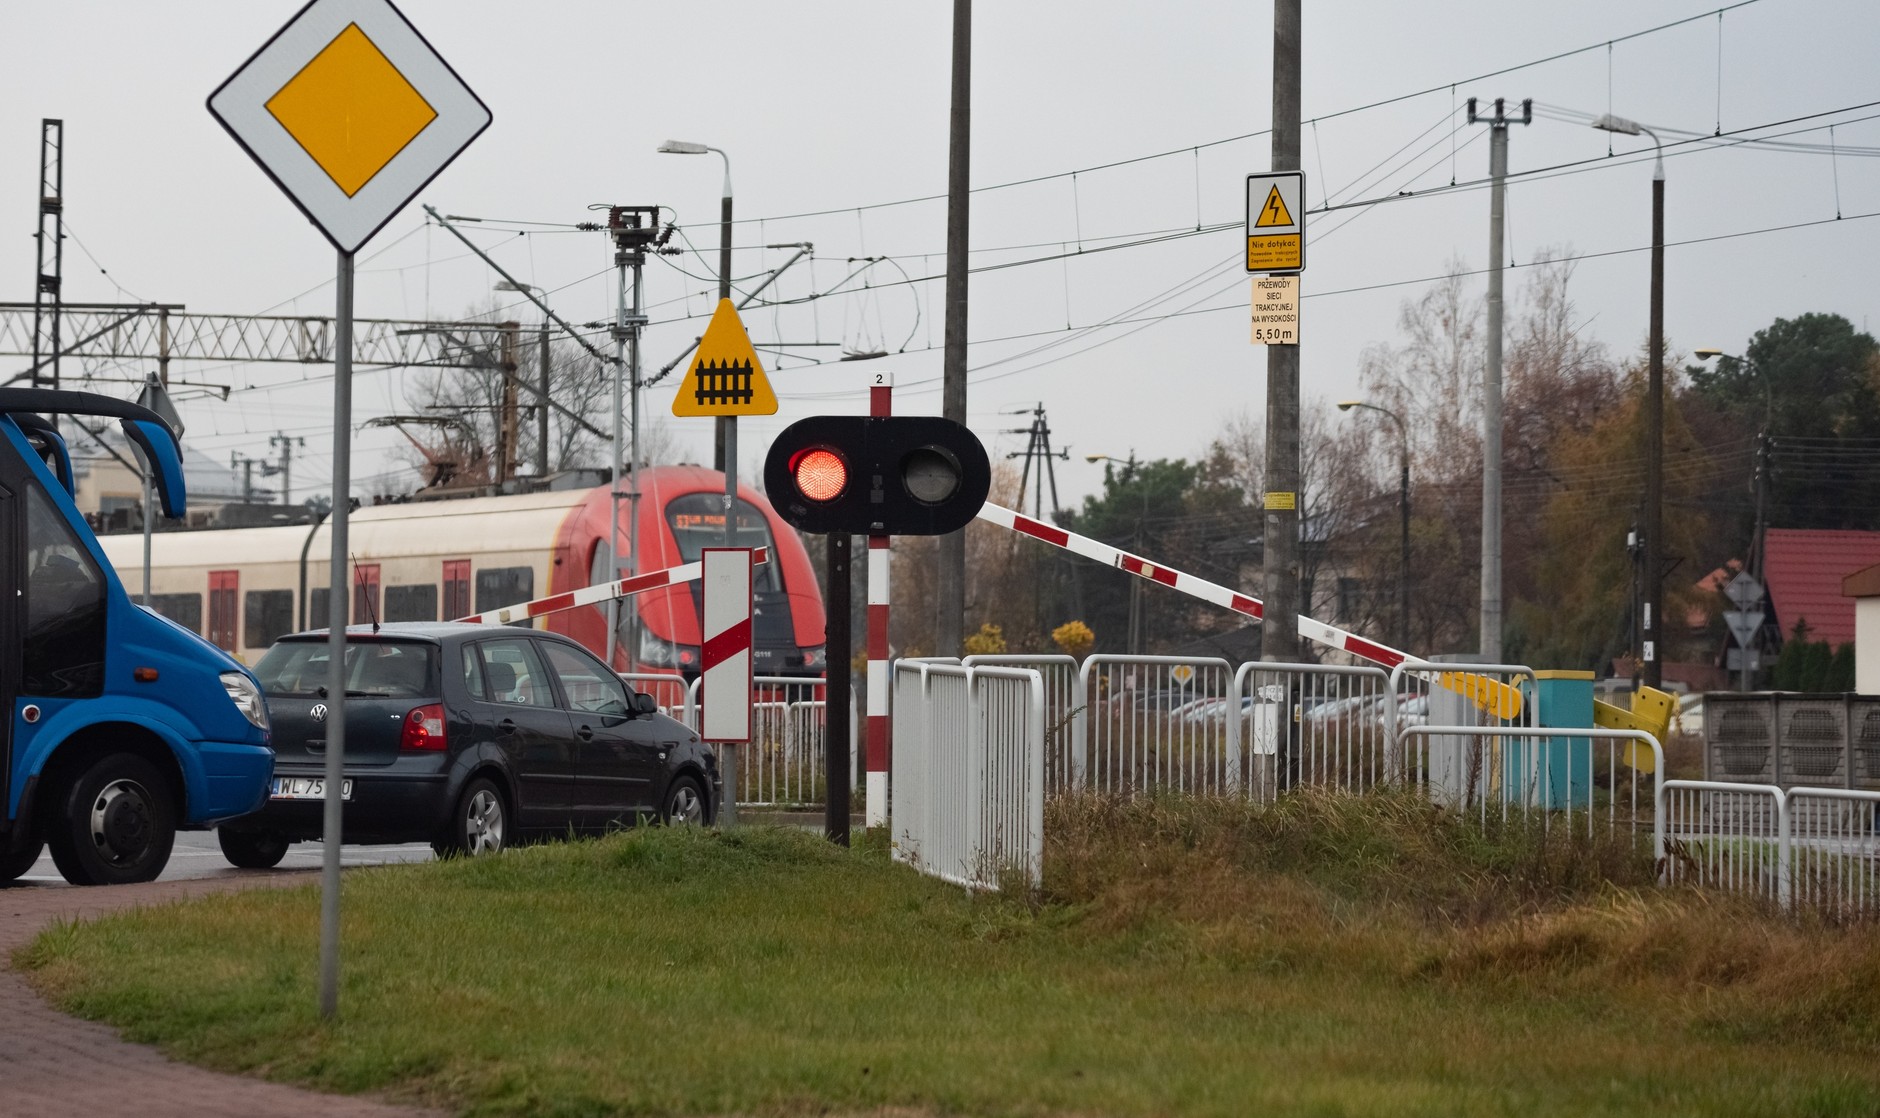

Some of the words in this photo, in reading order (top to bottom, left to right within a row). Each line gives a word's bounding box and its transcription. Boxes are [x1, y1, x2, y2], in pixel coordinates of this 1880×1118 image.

[1267, 239, 1296, 249] dotykać
[1258, 281, 1291, 289] PRZEWODY
[1266, 292, 1282, 300] SIECI
[1255, 303, 1293, 311] TRAKCYJNEJ
[1252, 315, 1260, 323] NA
[1261, 313, 1296, 322] WYSOKOŚCI
[1256, 328, 1280, 341] 5,50
[1282, 330, 1292, 339] m
[876, 374, 883, 384] 2
[281, 779, 299, 794] WL
[305, 779, 351, 795] 750
